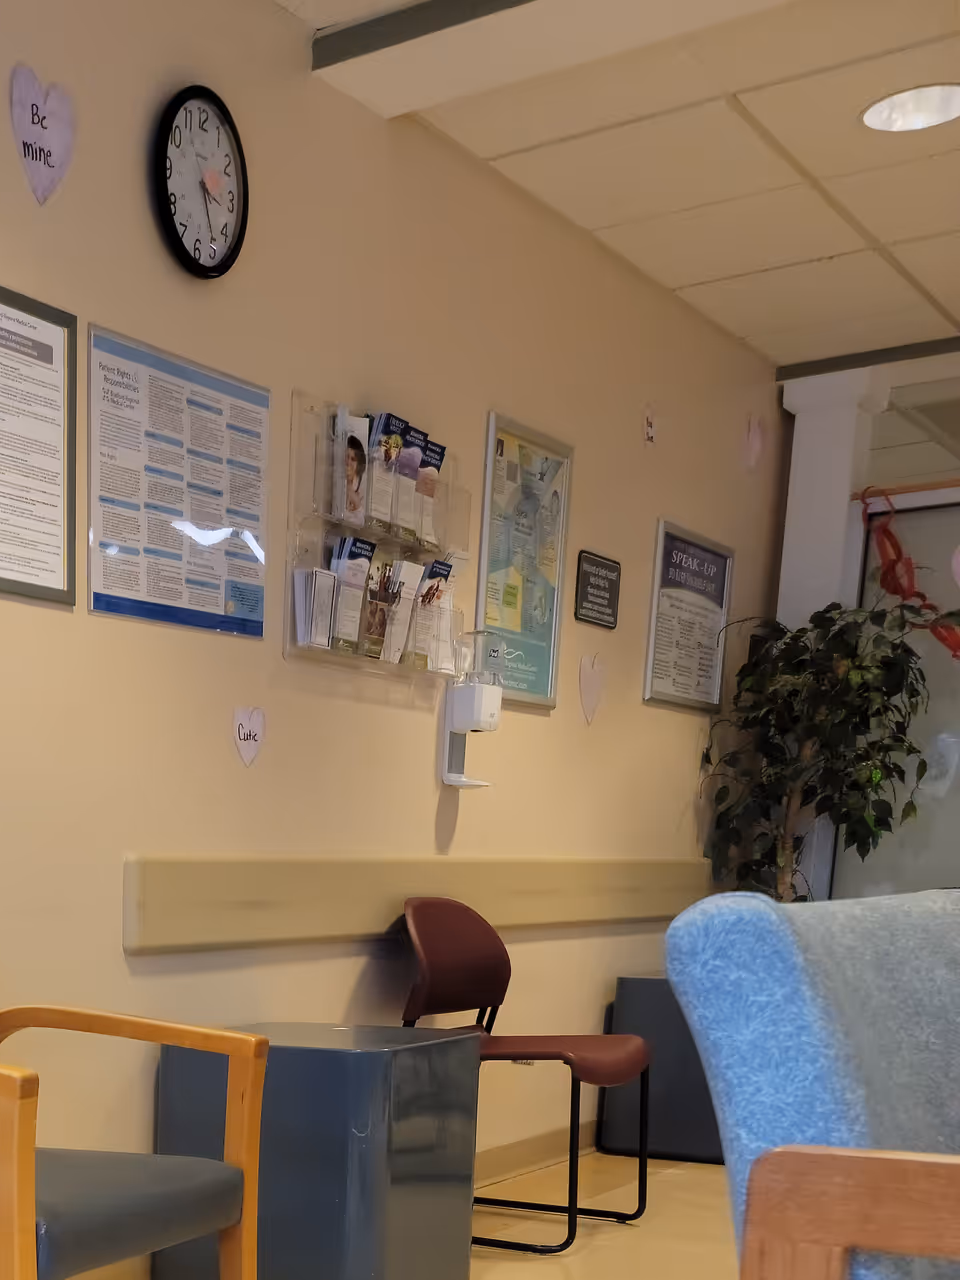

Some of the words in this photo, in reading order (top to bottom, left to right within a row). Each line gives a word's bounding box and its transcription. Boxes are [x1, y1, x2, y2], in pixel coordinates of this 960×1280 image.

[31, 103, 48, 130] Be
[183, 106, 193, 133] 11
[197, 106, 209, 133] 12
[170, 124, 182, 149] 10
[215, 125, 221, 149] 1
[22, 140, 55, 168] mine
[223, 153, 232, 178] 2
[166, 155, 173, 180] 9
[169, 192, 177, 217] 8
[227, 190, 235, 214] 3
[179, 221, 188, 239] 7
[220, 221, 229, 244] 4
[193, 238, 202, 261] 6
[208, 236, 217, 261] 5
